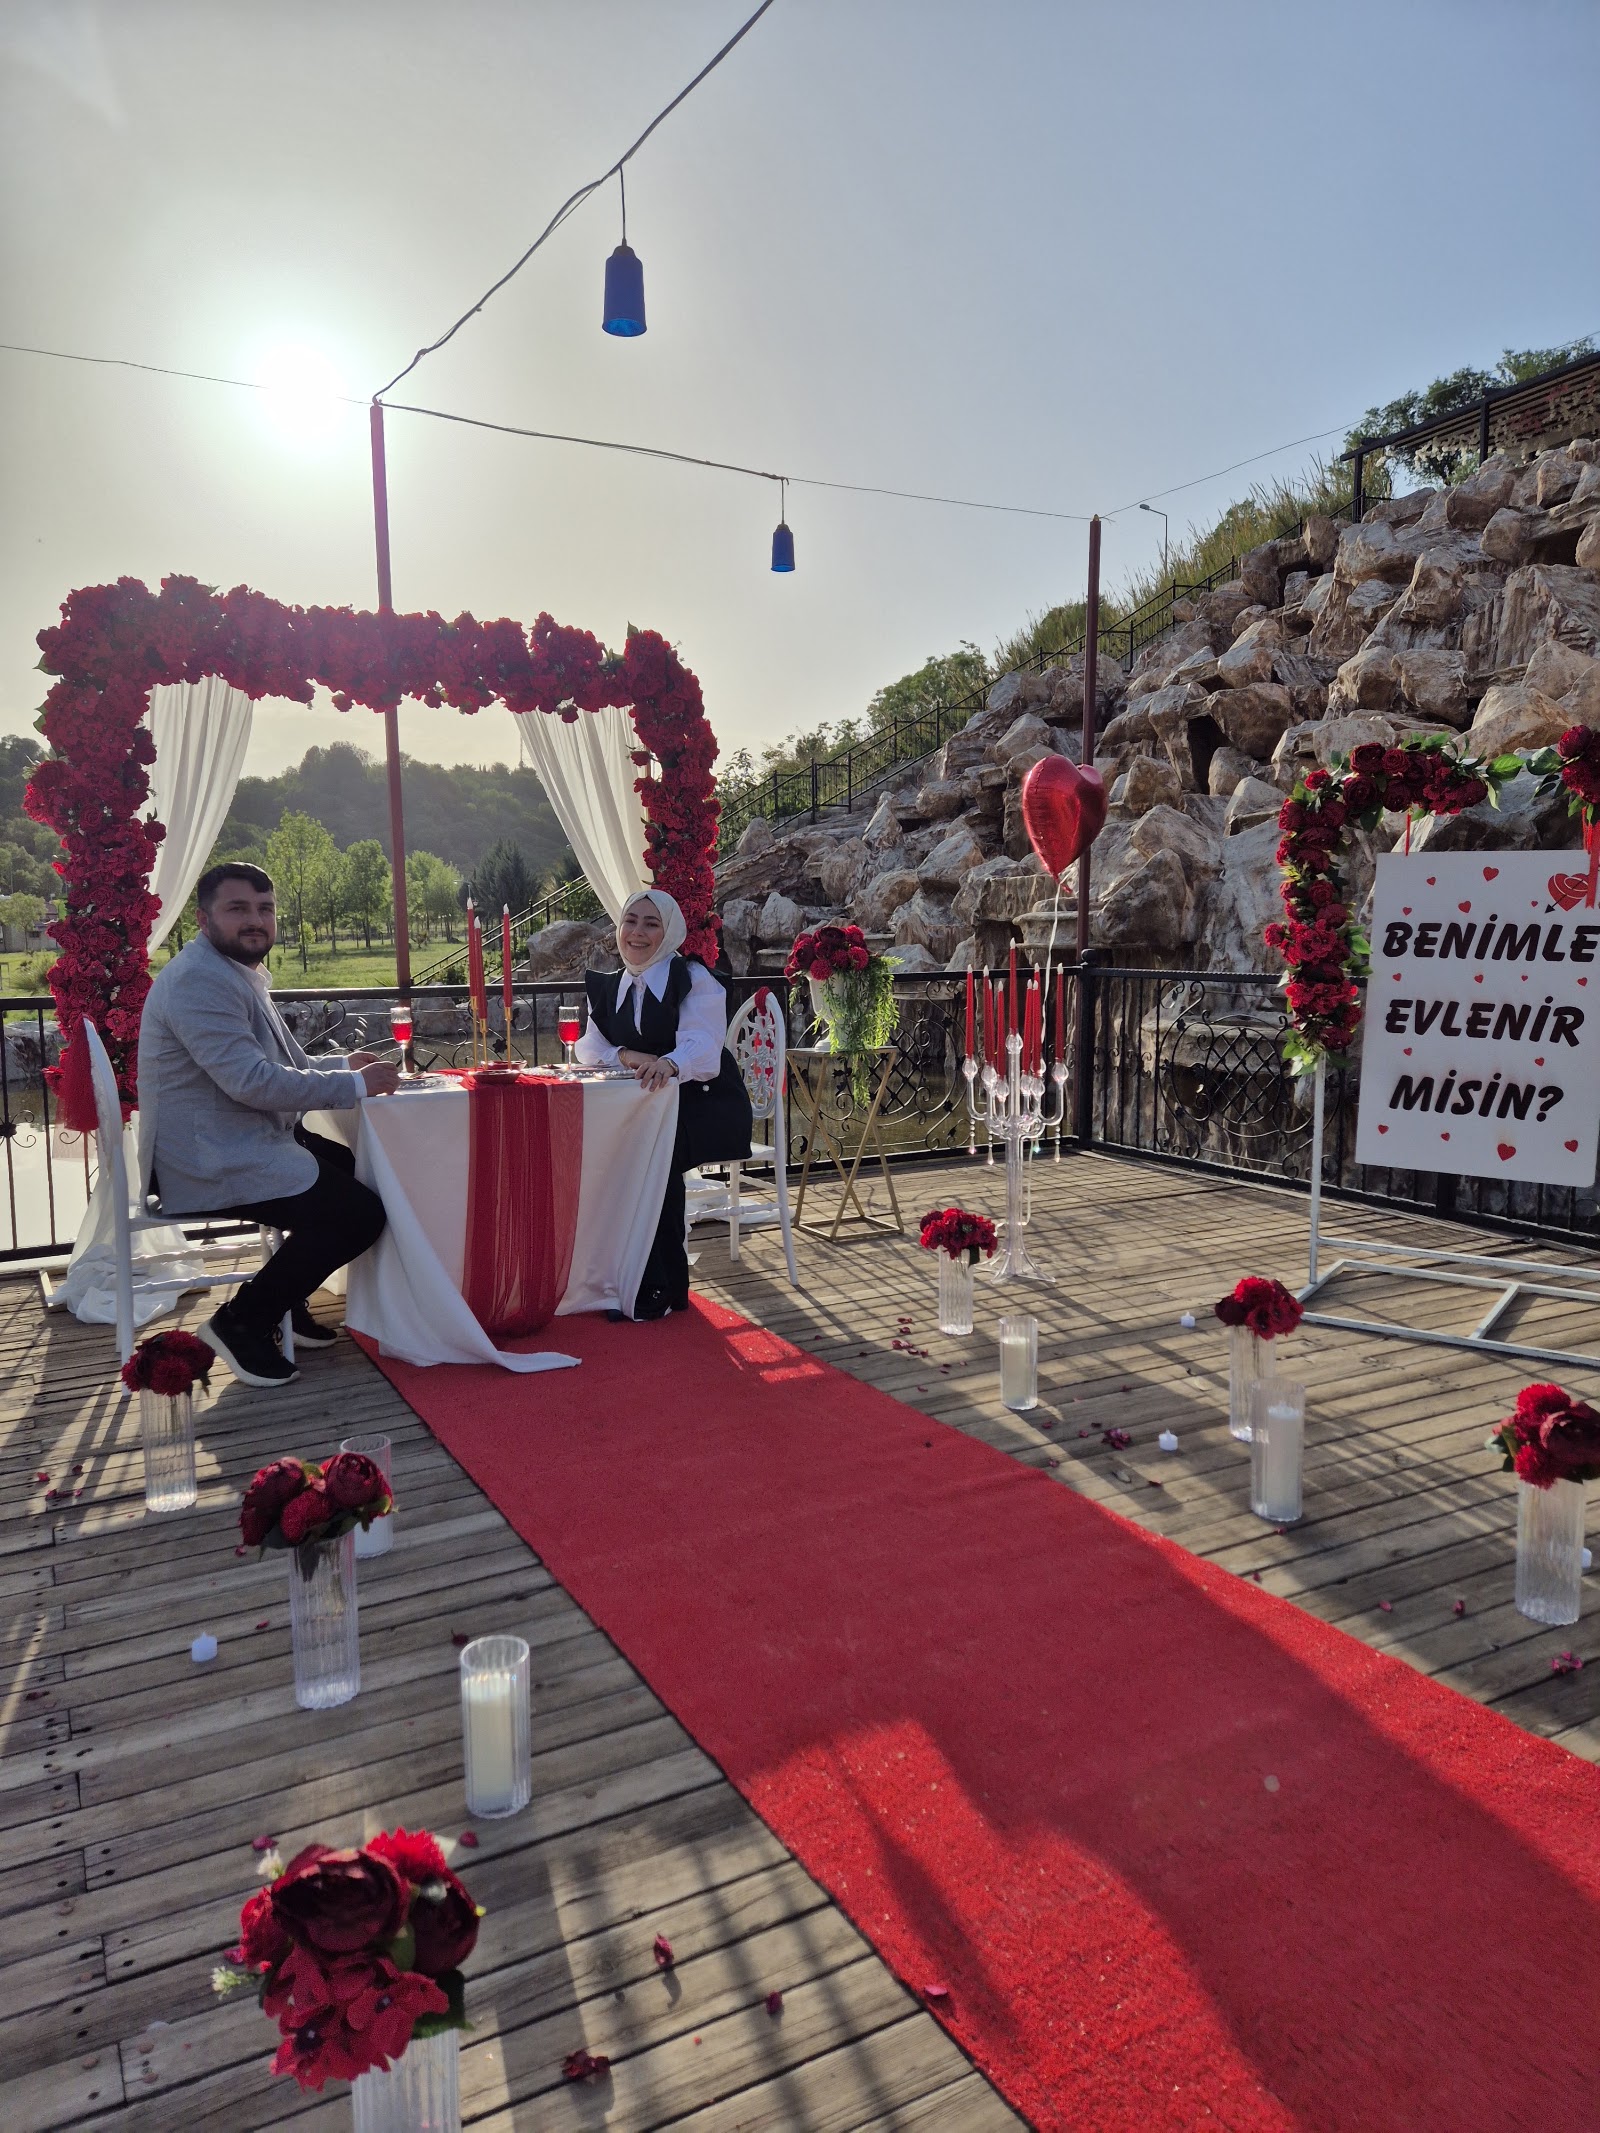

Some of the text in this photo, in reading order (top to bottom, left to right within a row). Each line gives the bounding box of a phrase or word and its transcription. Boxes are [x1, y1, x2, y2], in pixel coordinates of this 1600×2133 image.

[1382, 913, 1600, 962] BENİMLE
[1385, 995, 1585, 1047] EVLENİR
[1389, 1069, 1564, 1122] MİSİN?
